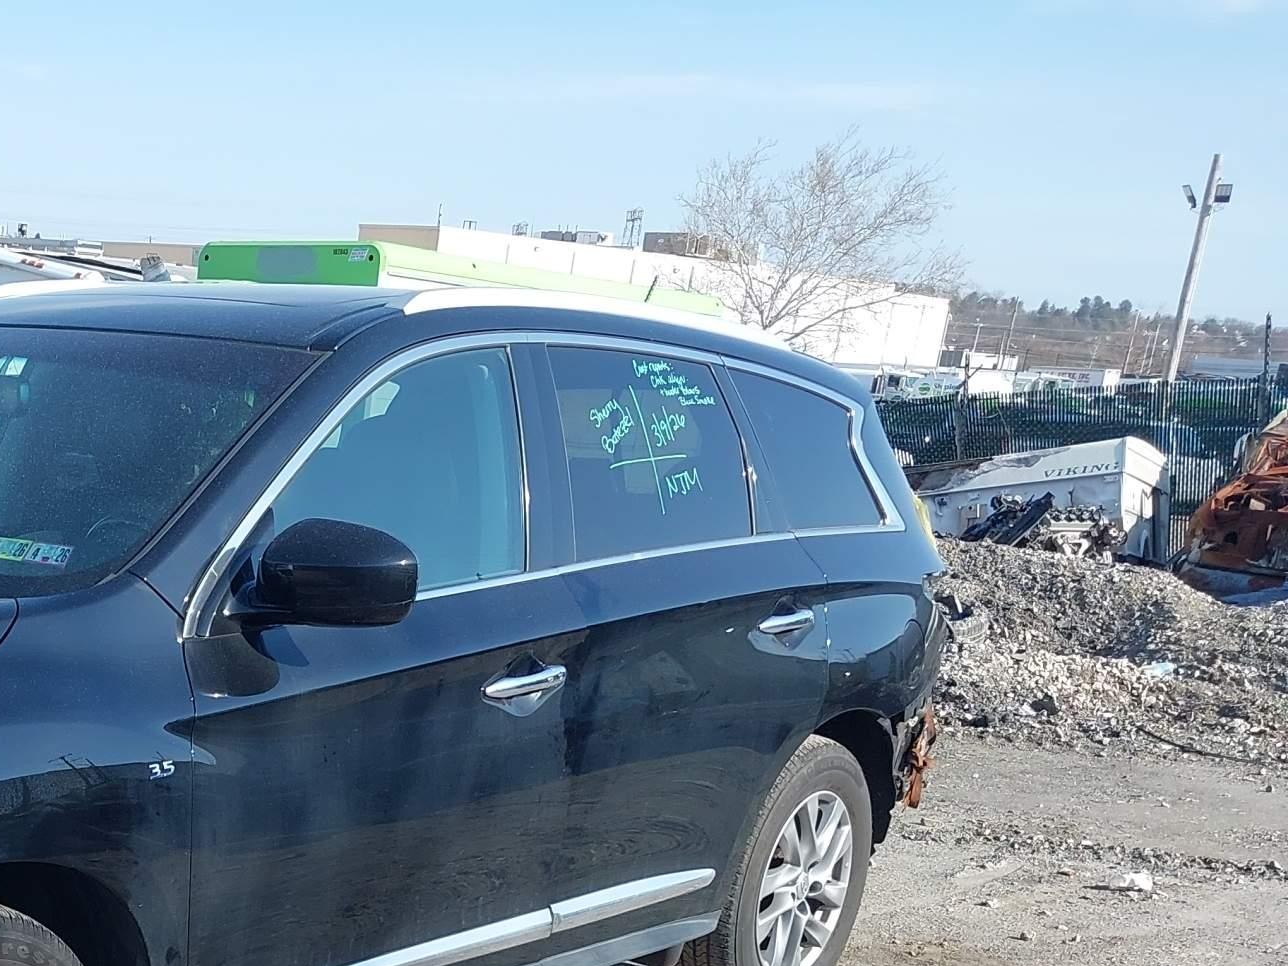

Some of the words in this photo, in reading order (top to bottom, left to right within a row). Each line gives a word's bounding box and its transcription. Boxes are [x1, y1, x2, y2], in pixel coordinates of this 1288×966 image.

[651, 405, 686, 447] 3/9/26
[665, 467, 703, 499] NJM
[1044, 462, 1119, 478] VIKING
